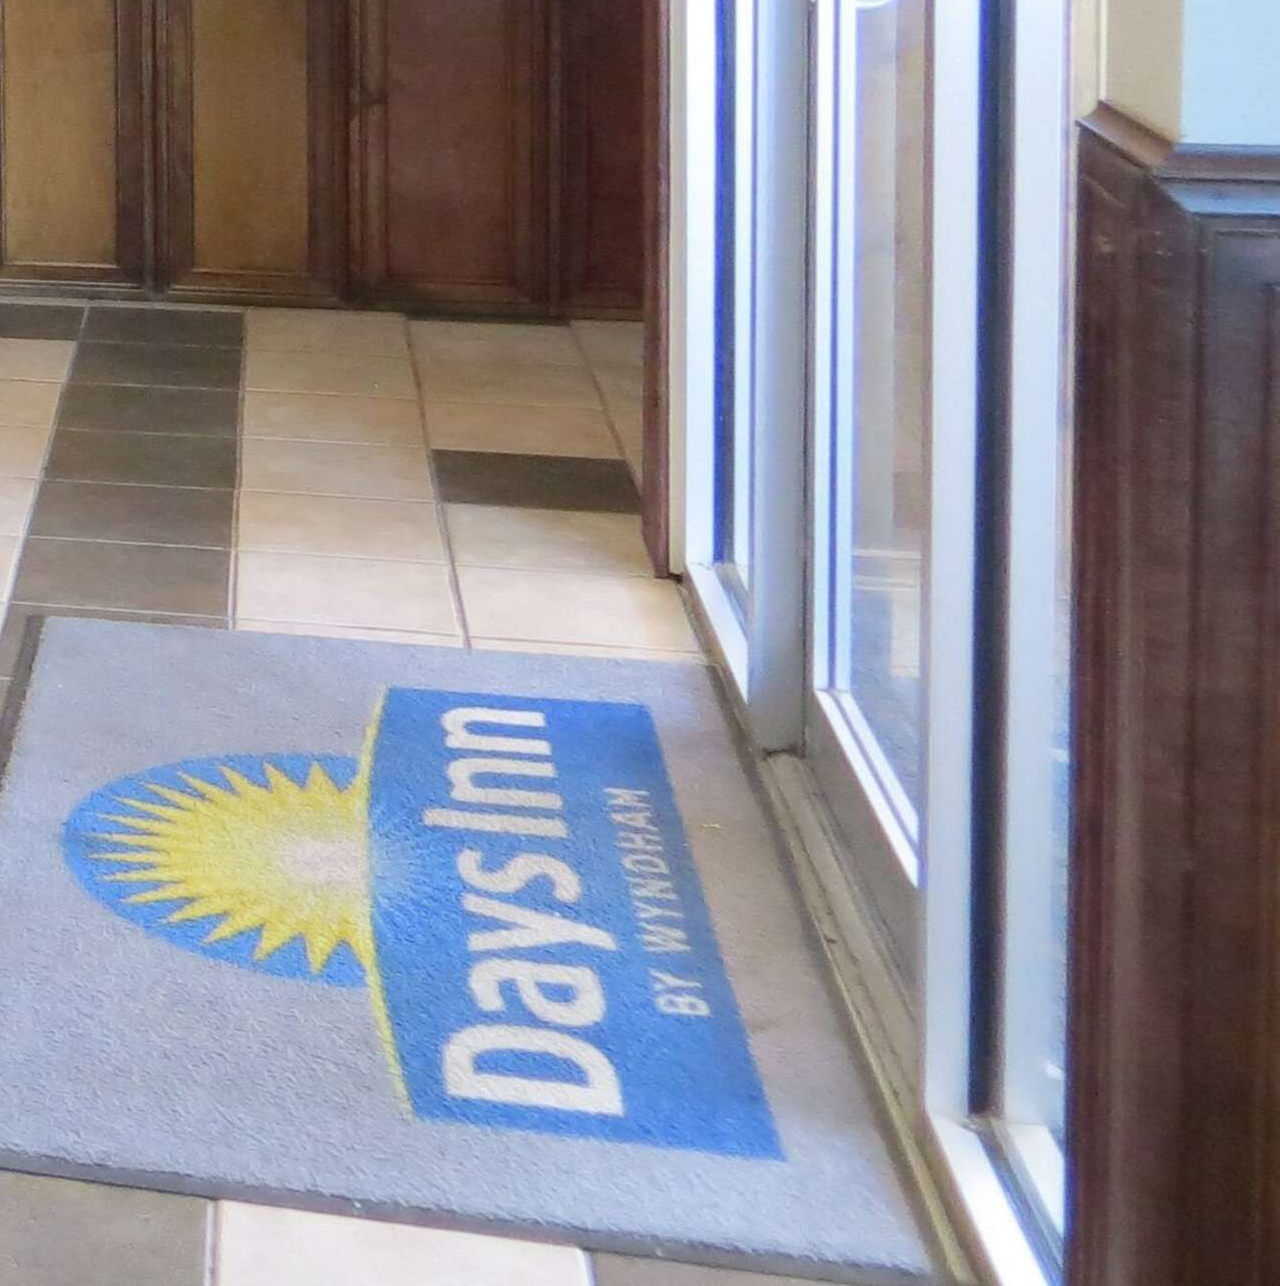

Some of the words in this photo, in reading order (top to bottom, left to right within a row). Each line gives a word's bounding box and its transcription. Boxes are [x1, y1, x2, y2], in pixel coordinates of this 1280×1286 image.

[423, 706, 570, 839] Inn
[604, 787, 692, 954] WYNDHAM
[443, 848, 626, 1118] Days
[649, 968, 712, 1018] BY
